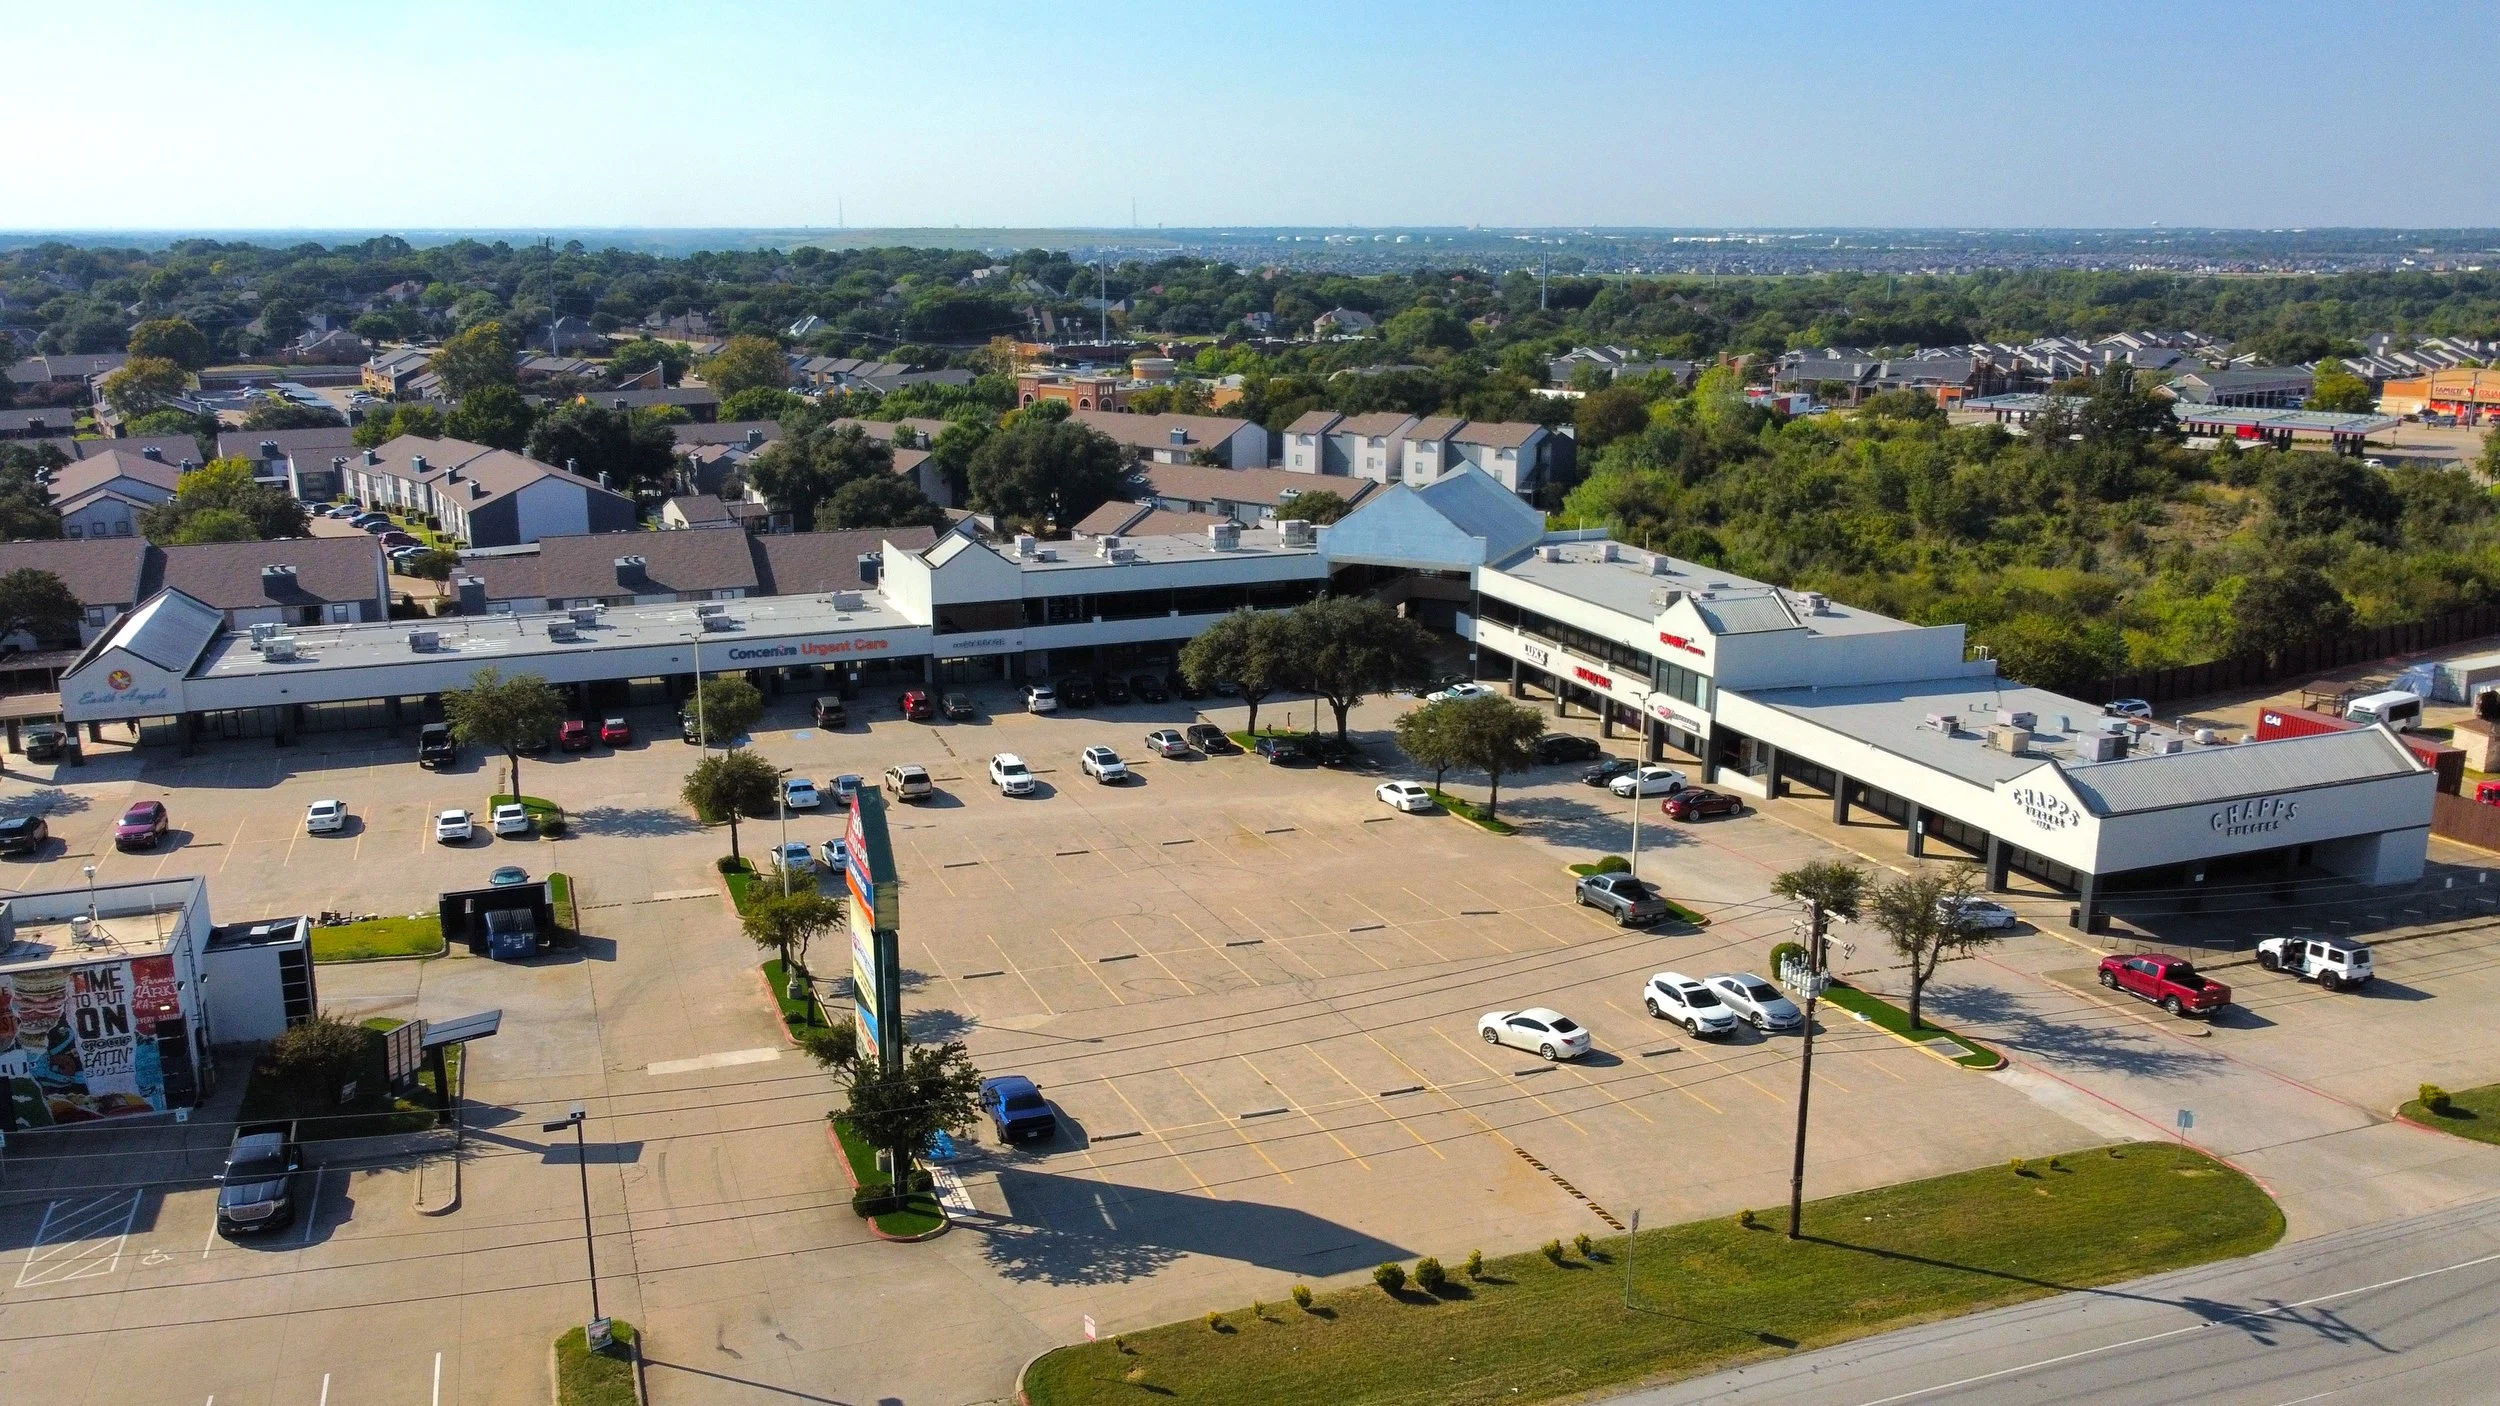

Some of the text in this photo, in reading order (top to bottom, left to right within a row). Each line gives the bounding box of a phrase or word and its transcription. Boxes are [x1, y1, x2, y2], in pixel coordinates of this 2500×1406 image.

[729, 638, 888, 660] Concentra Urgent Care
[2012, 788, 2080, 827] CHAPPS
[2211, 798, 2300, 833] CHAPPS
[2226, 820, 2280, 837] BURGERS
[70, 966, 124, 994] TIME
[72, 989, 125, 1009] TO PUT
[75, 1003, 130, 1040] ON
